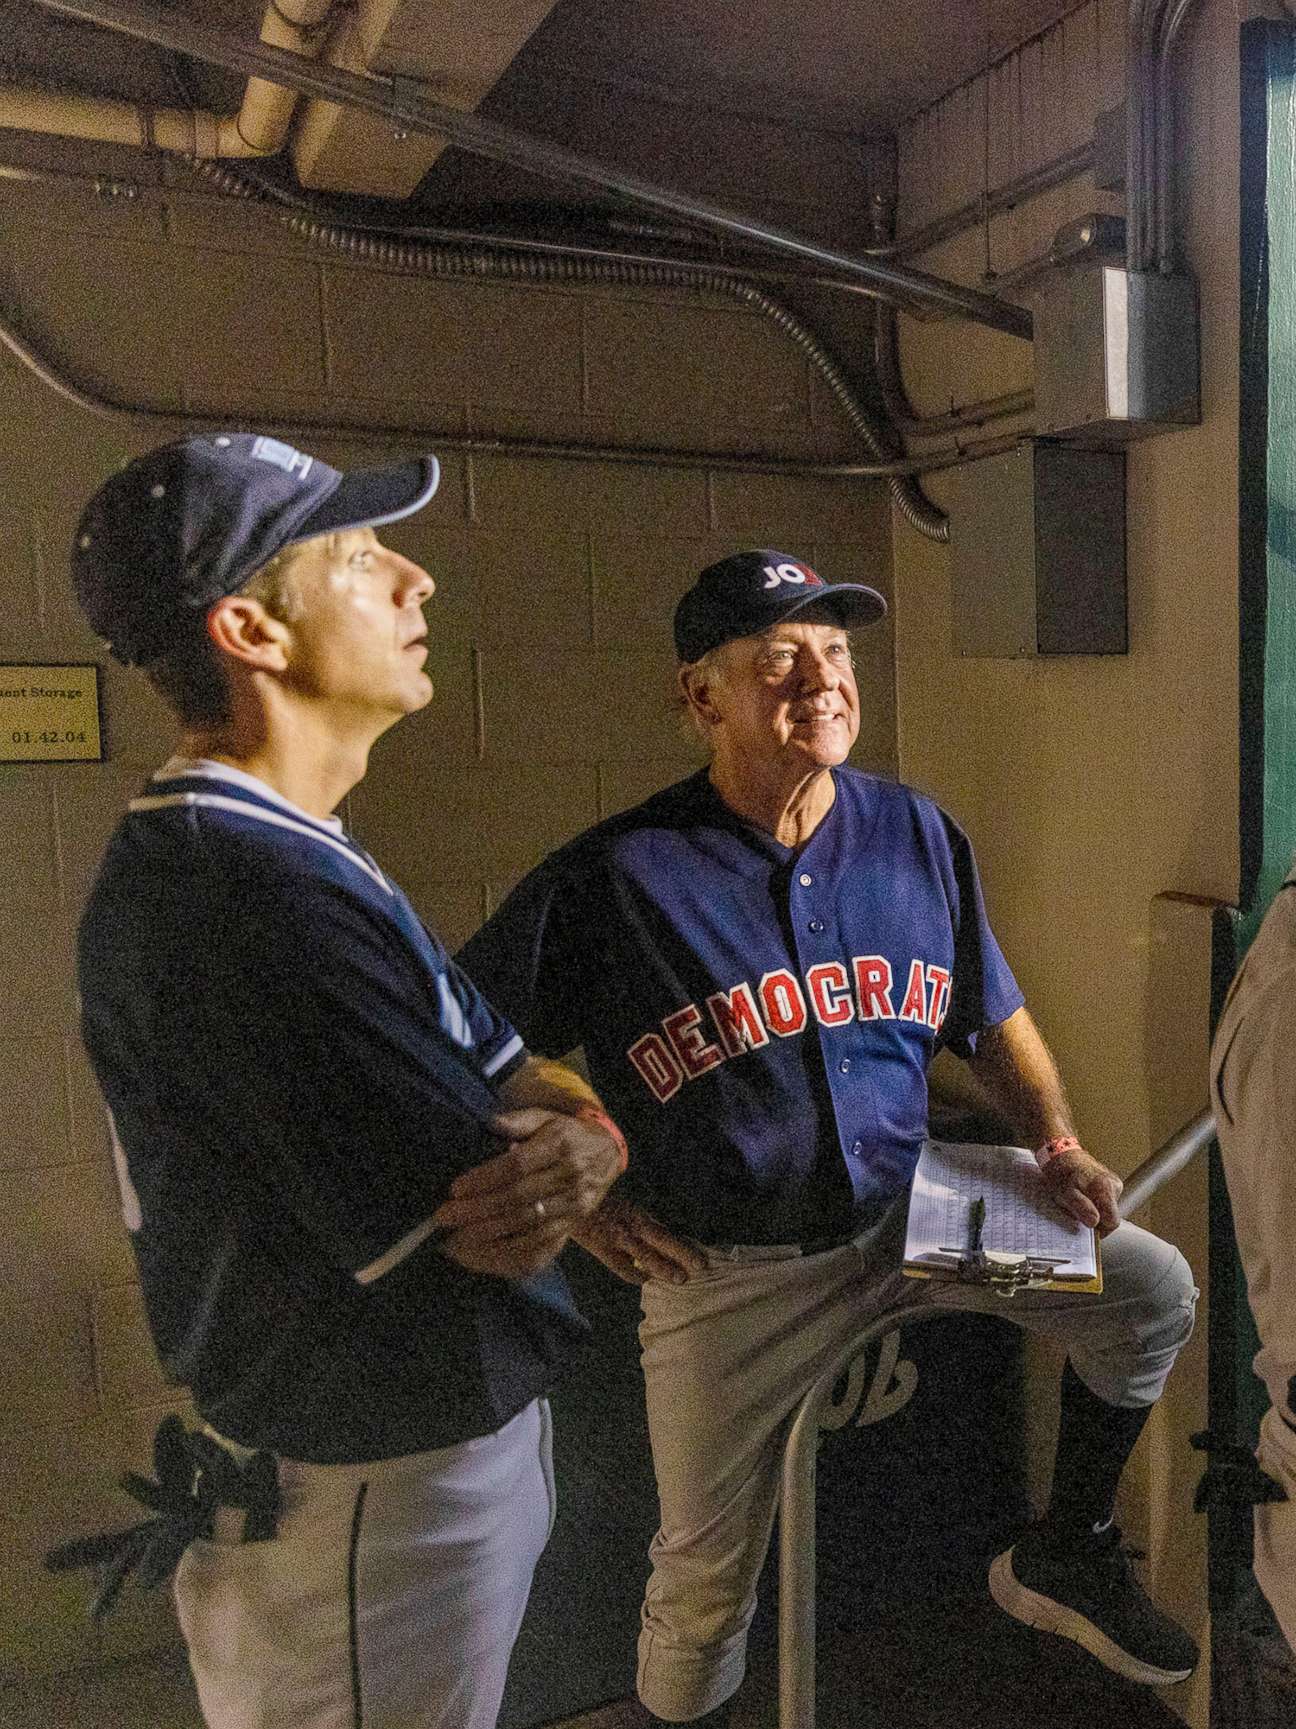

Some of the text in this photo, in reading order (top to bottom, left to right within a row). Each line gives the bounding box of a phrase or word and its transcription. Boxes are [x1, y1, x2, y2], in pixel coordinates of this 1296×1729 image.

[30, 687, 82, 699] Storage
[12, 731, 88, 743] 01.42.04
[627, 955, 952, 1104] DEMOCRAT
